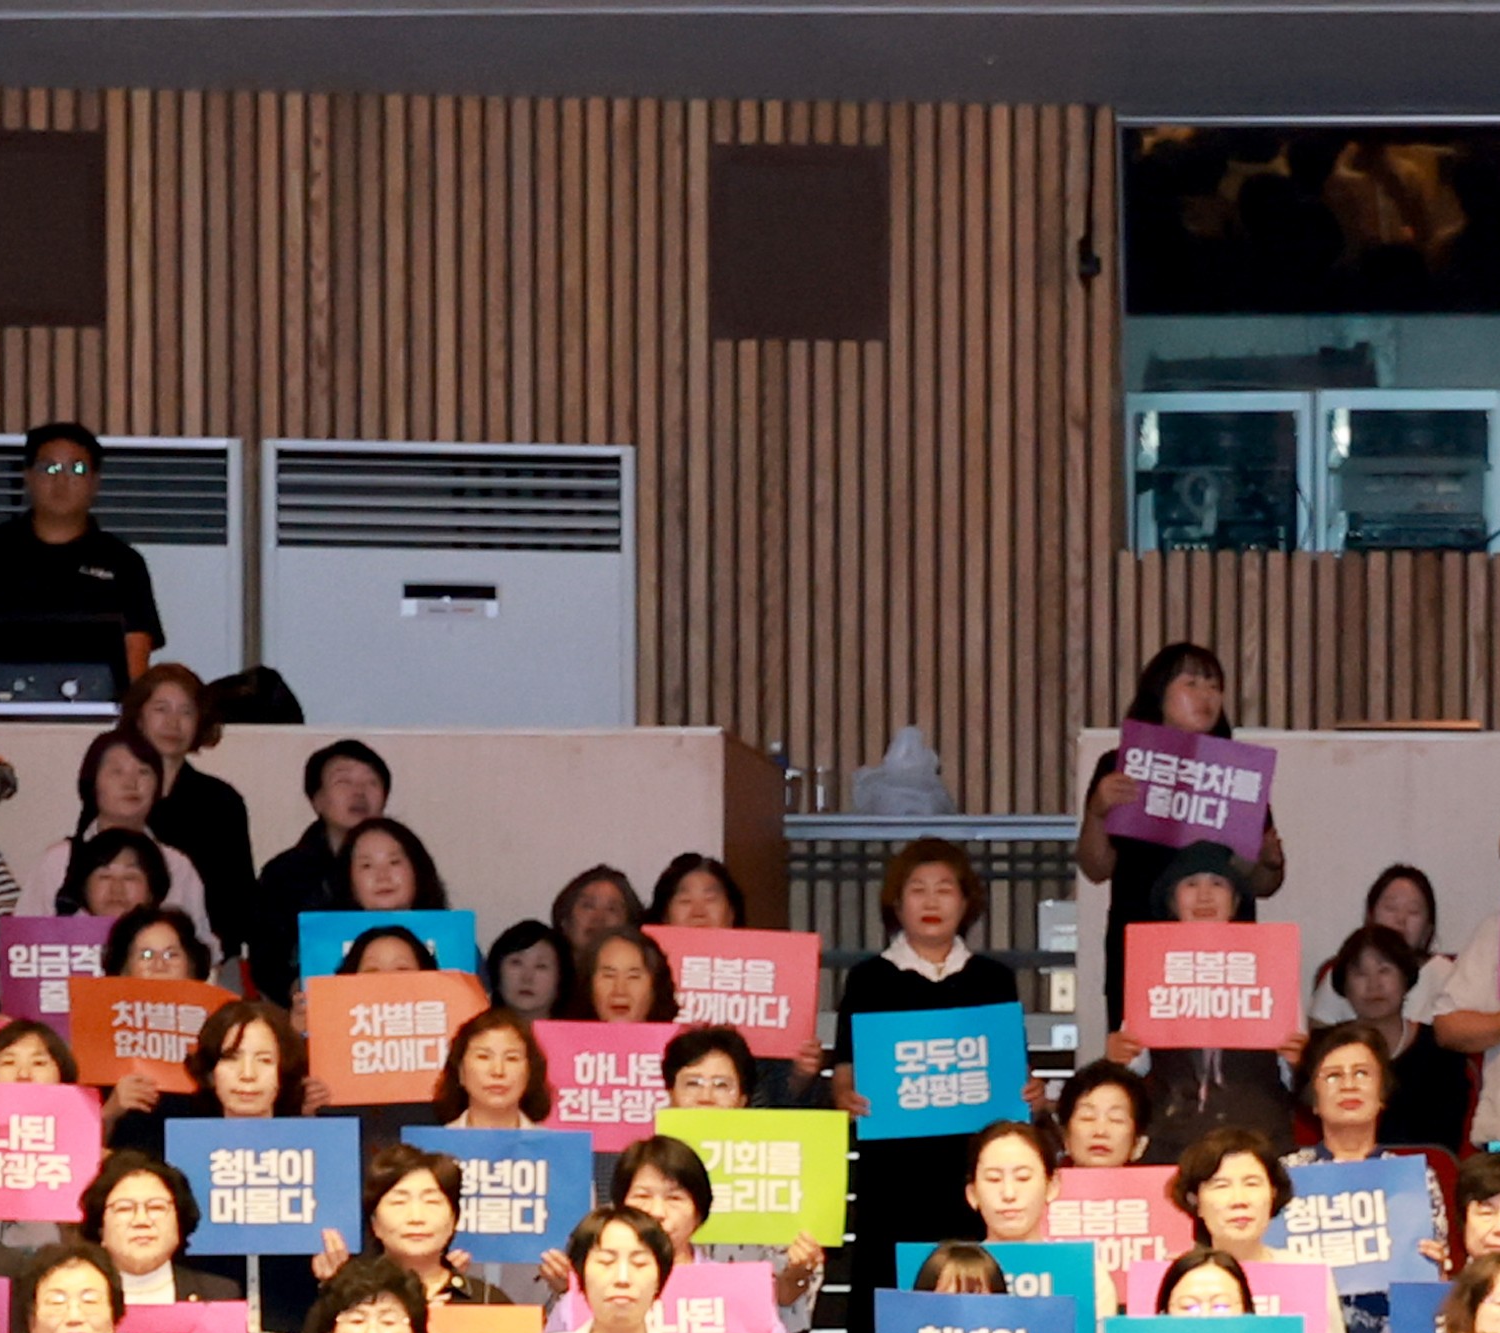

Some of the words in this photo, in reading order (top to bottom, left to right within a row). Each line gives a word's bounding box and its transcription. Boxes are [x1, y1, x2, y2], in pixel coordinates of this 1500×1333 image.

[1125, 749, 1262, 805] 임금격차를
[1146, 790, 1228, 829] 줄이다
[682, 957, 774, 995] 돌봄을
[1166, 952, 1255, 984] 돌봄을
[114, 1002, 206, 1034] 차별을
[351, 1001, 446, 1036] 차별을
[1150, 987, 1273, 1018] 함께하다
[352, 1037, 447, 1073] 없애다
[575, 1053, 664, 1086] 하나된
[896, 1037, 987, 1073] 모두의
[899, 1071, 989, 1108] 성평등
[210, 1149, 313, 1185] 청년이
[702, 1142, 801, 1175] 기회를
[460, 1159, 548, 1196] 청년이
[211, 1187, 316, 1224] 머물다
[1049, 1200, 1148, 1235] 돌봄을
[1283, 1189, 1386, 1229] 청년이
